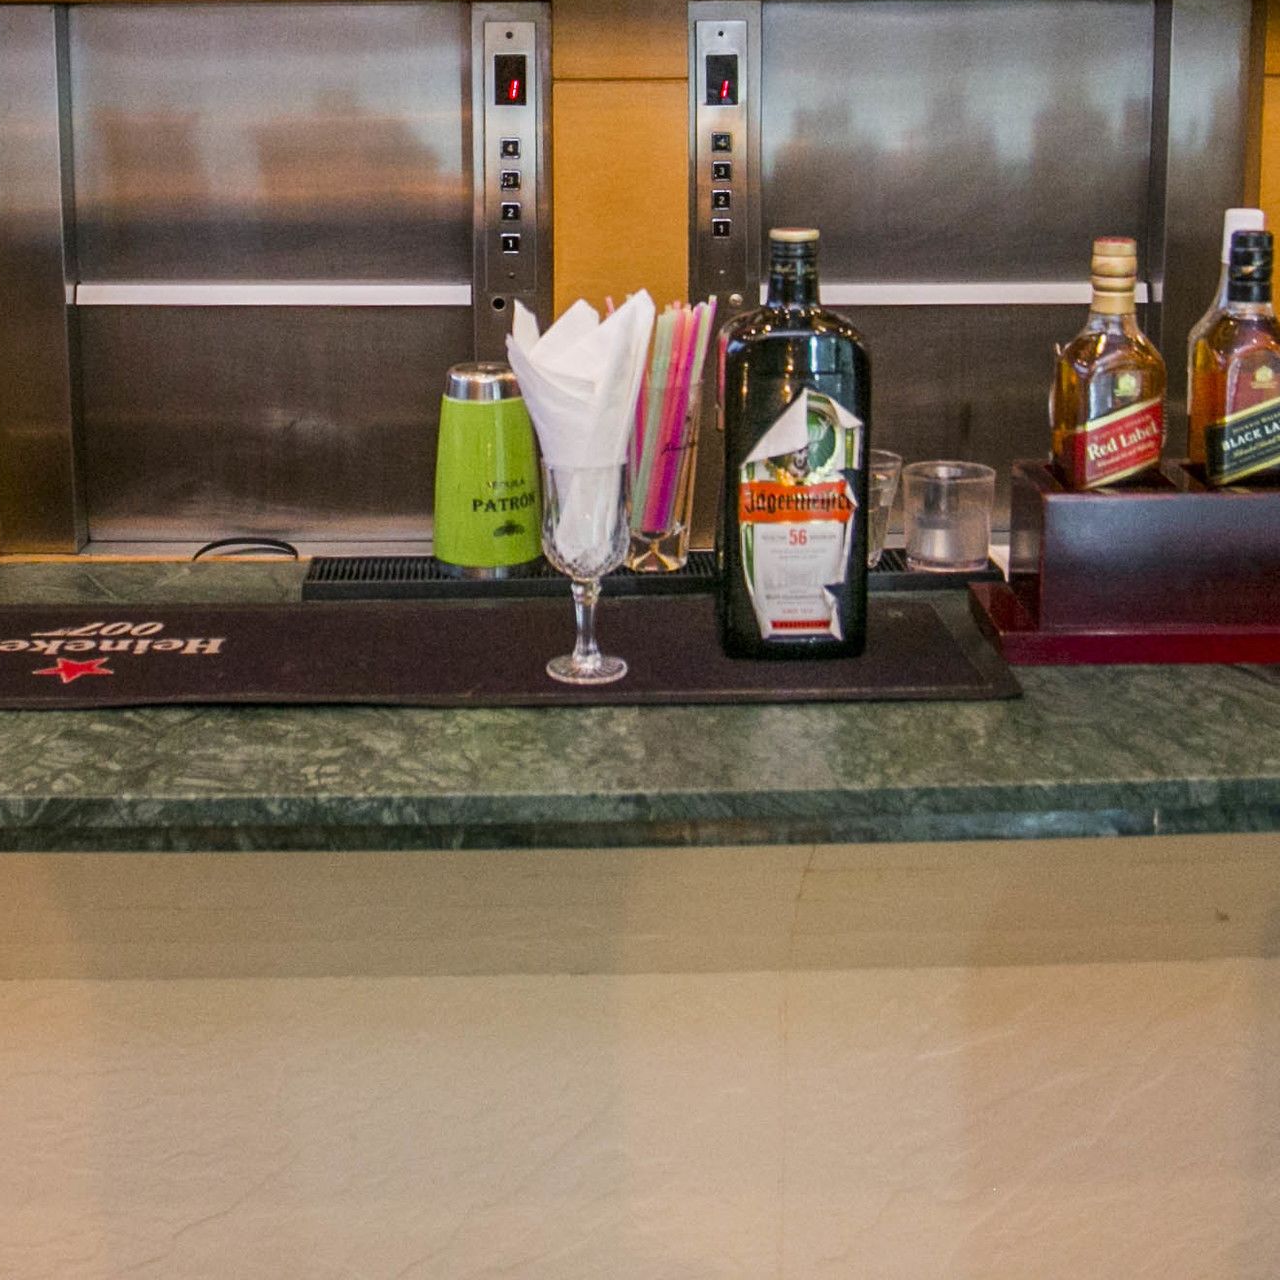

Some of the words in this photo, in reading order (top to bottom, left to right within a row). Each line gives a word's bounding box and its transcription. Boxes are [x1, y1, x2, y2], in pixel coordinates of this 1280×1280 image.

[719, 167, 726, 176] 3
[718, 195, 725, 205] 2
[507, 208, 514, 218] 2
[719, 225, 724, 234] 1
[508, 239, 514, 248] 1
[1086, 437, 1119, 460] Red
[1120, 420, 1157, 448] Label
[1222, 428, 1263, 451] BLACK
[789, 528, 808, 546] 56
